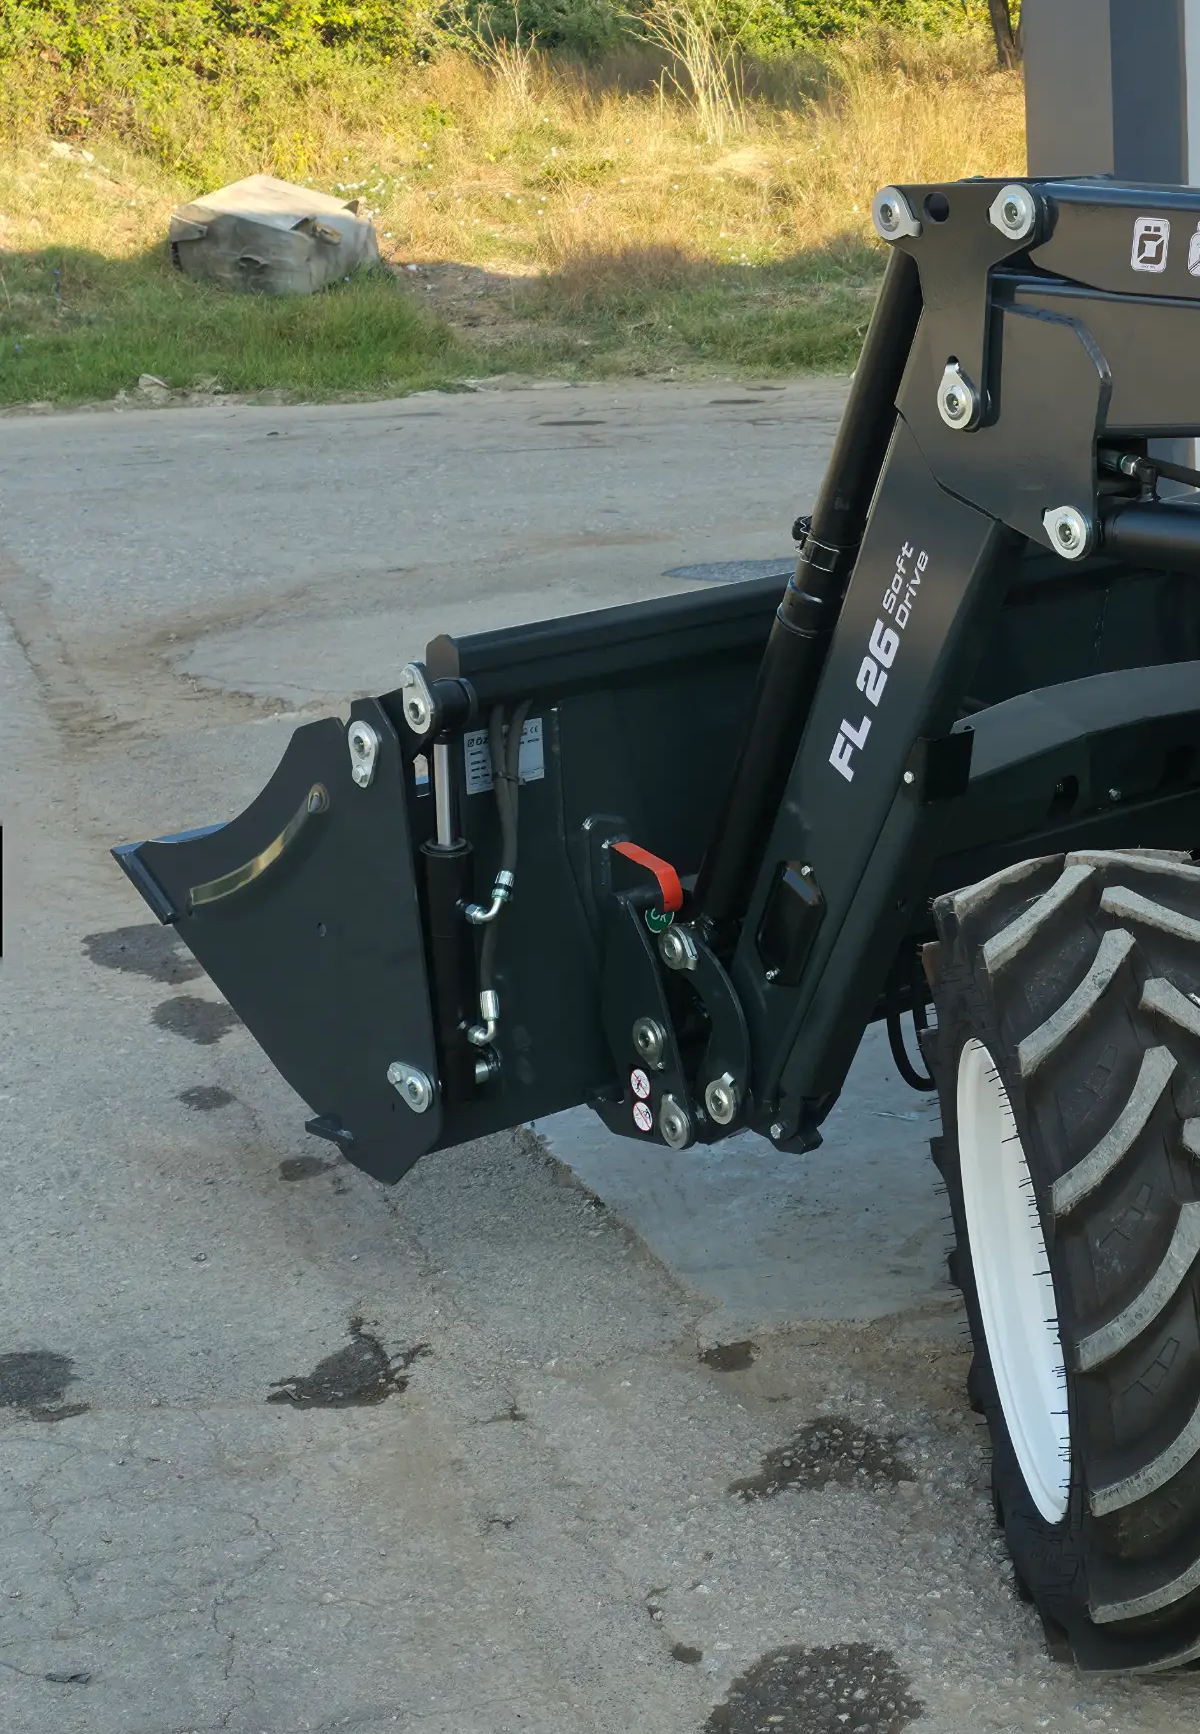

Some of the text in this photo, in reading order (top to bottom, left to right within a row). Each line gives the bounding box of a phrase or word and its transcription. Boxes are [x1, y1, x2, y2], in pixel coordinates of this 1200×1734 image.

[882, 541, 914, 614] Soft
[895, 550, 929, 630] Drive
[829, 618, 900, 782] FL 26
